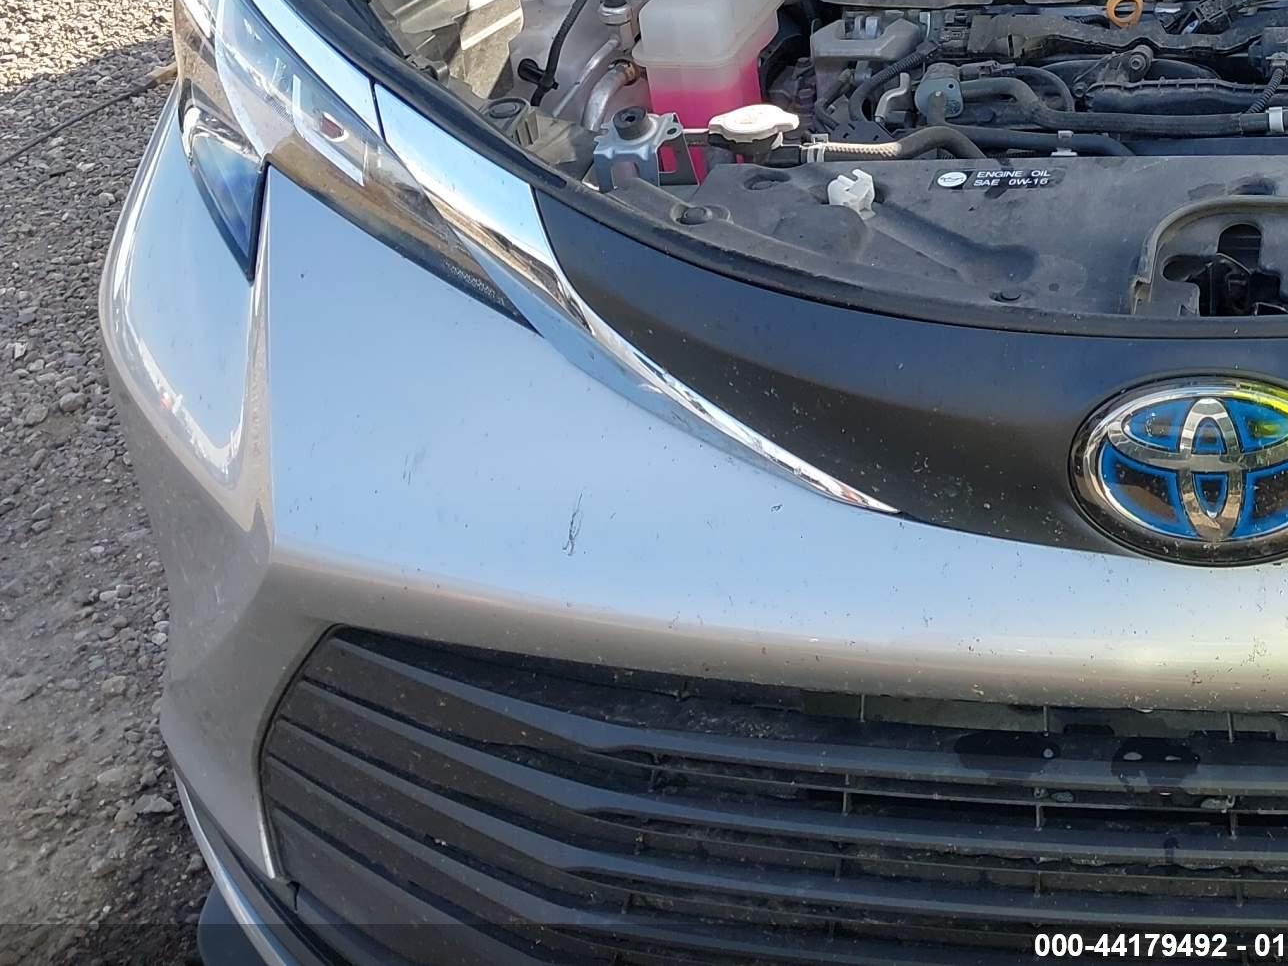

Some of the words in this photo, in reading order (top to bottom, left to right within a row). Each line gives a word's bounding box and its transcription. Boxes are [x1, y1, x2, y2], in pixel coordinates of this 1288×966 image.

[976, 170, 1024, 178] ENGINE
[1031, 169, 1051, 177] OIL
[1008, 178, 1048, 186] 0W-16
